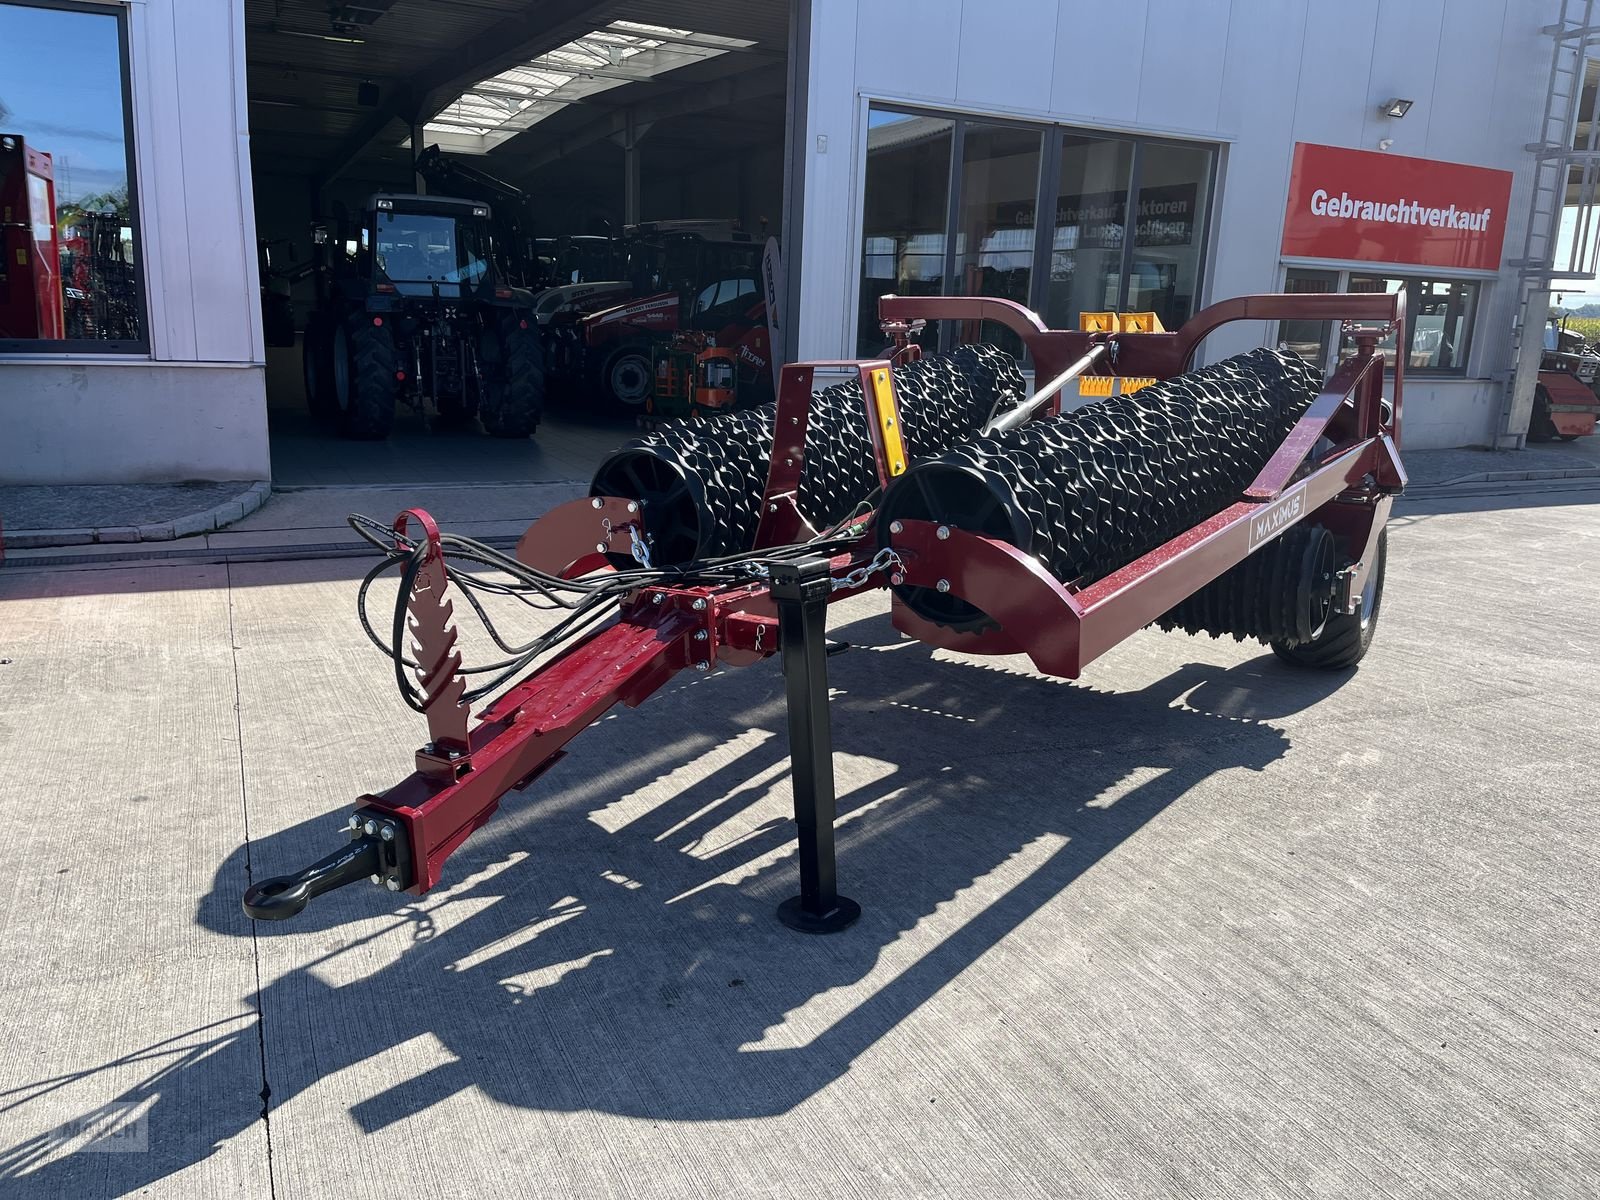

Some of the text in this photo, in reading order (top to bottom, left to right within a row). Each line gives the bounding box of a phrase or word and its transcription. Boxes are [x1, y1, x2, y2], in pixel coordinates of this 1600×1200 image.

[1310, 188, 1491, 232] Gebrauchtverkauf
[625, 300, 669, 314] MASSEY FERGUSON
[740, 344, 766, 368] TITAN
[1256, 495, 1300, 540] MAXIMUS
